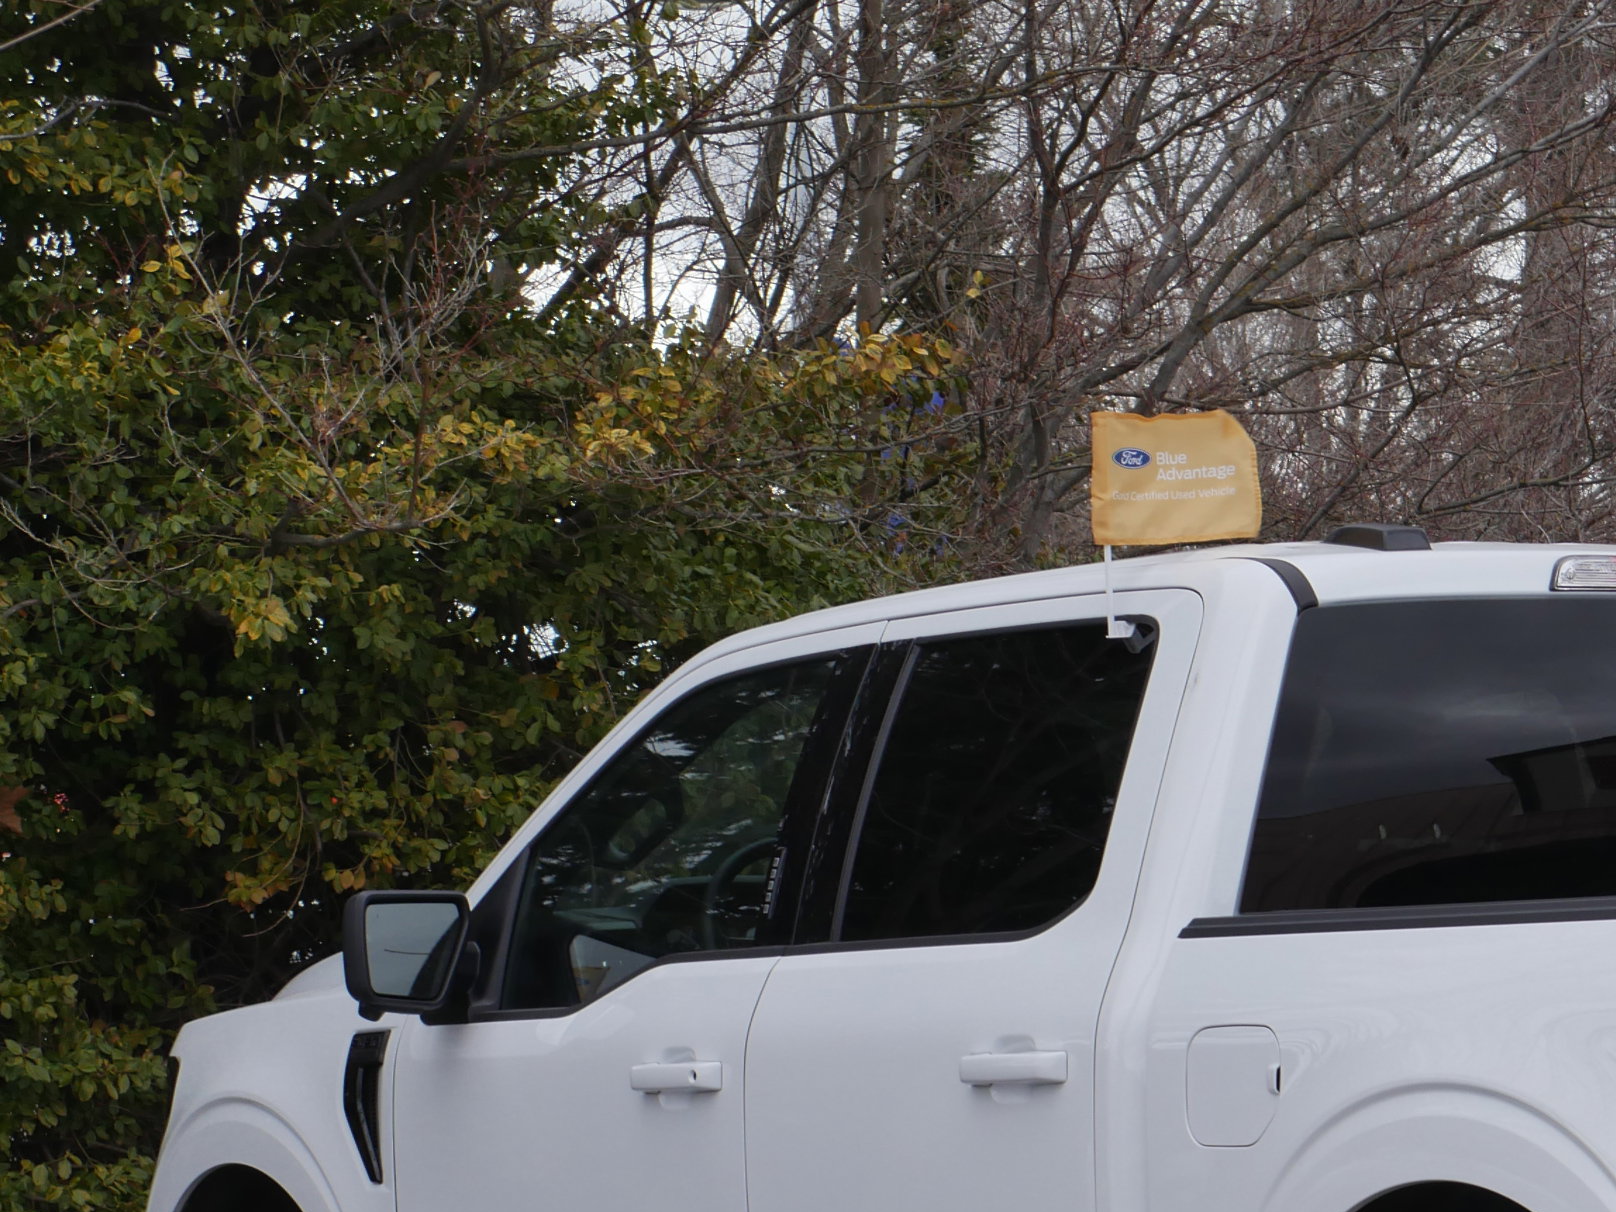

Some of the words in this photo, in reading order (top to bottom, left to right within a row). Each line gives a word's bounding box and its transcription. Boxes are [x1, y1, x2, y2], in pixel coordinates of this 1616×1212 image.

[1120, 451, 1143, 465] Ford
[1157, 452, 1187, 464] Blue
[1156, 464, 1235, 480] Advantage
[1129, 490, 1168, 500] Certified
[1171, 490, 1195, 499] Used
[1198, 487, 1235, 497] Vehicle
